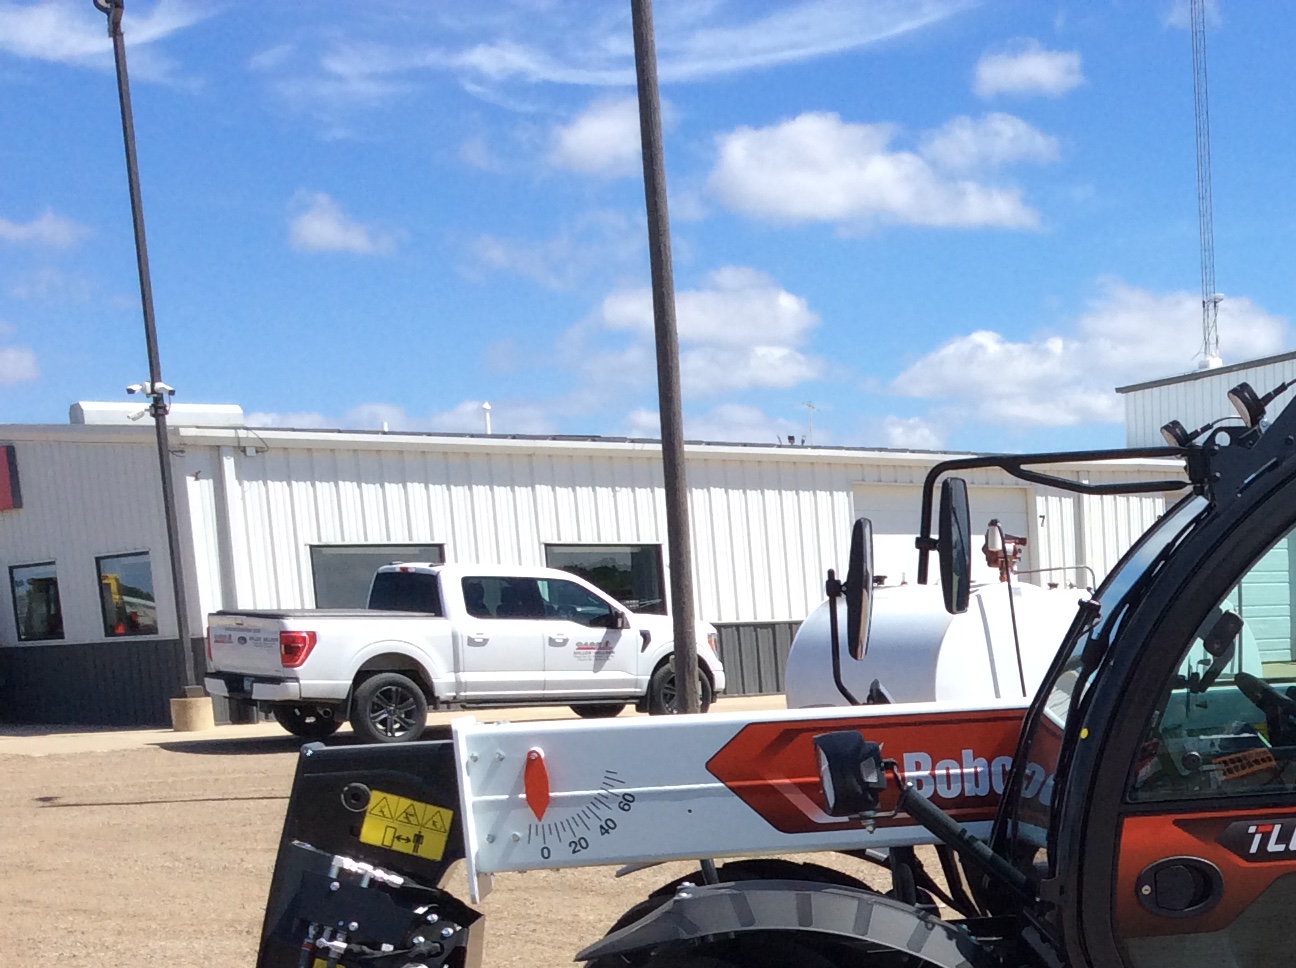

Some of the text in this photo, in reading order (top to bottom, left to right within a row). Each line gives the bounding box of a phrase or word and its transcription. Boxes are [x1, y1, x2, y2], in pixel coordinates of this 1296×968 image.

[1039, 514, 1046, 528] 7
[541, 792, 636, 859] 0 20 40 60
